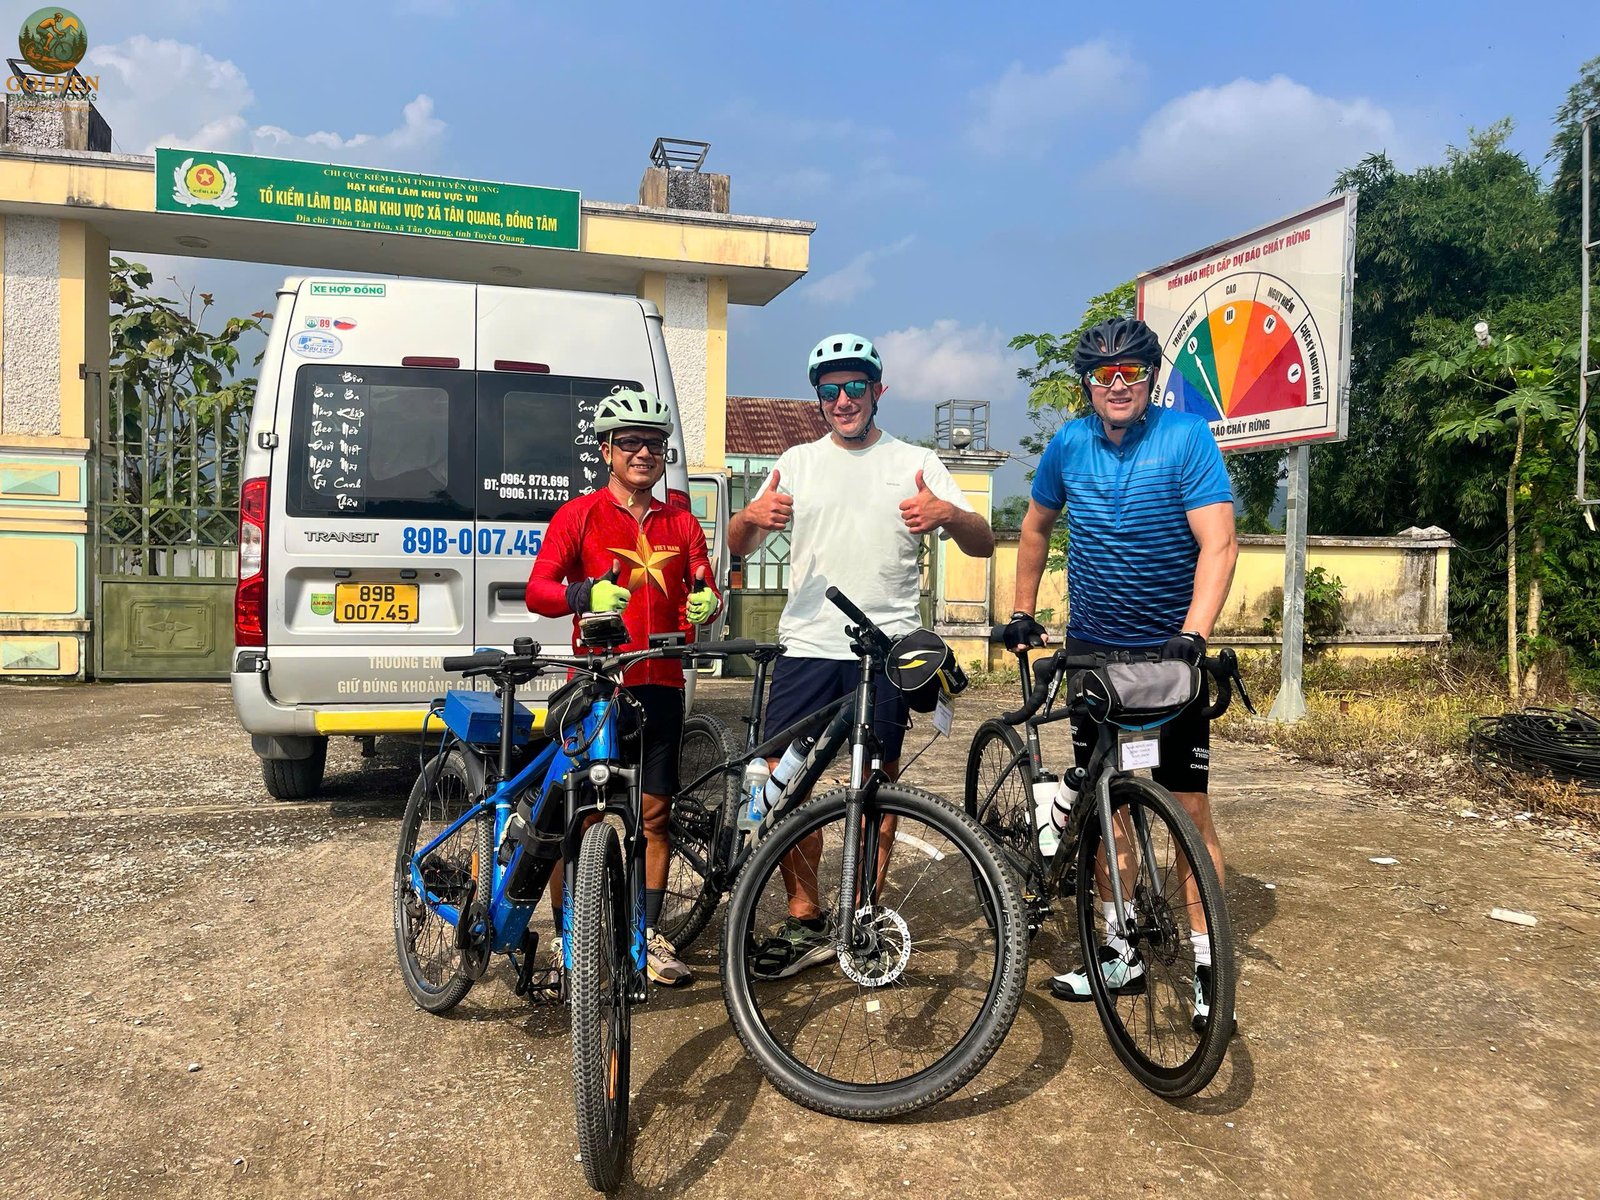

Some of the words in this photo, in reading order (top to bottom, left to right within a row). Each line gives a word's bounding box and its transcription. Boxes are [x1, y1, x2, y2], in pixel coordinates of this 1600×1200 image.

[323, 169, 340, 177] CHI
[342, 172, 361, 180] CỤC
[390, 174, 411, 184] LÂM
[437, 179, 466, 190] TUYÊN
[468, 185, 499, 194] QUANG
[347, 182, 365, 192] HẠT
[397, 186, 418, 197] LÂM
[421, 190, 441, 199] KHU
[443, 191, 463, 202] VỰC
[465, 194, 478, 203] VII
[259, 184, 273, 204] TỔ
[276, 186, 304, 207] KIỂM
[307, 191, 330, 209] LÂM
[333, 196, 352, 214] ĐỊA
[354, 197, 377, 214] BÀN
[380, 201, 401, 216] KHU
[403, 203, 424, 221] VỰC
[427, 204, 441, 220] XÃ
[443, 205, 464, 223] TÂN
[466, 209, 504, 228] QUANG,
[506, 210, 533, 229] ĐỒNG
[536, 214, 557, 232] TÂM
[295, 214, 311, 223] Địa
[331, 217, 352, 227] Thôn
[354, 220, 371, 229] Tân
[407, 224, 423, 233] Tân
[473, 231, 497, 241] Tuyên
[498, 234, 525, 244] Quang
[1184, 270, 1198, 284] BÁO
[1199, 264, 1215, 279] HIỆU
[1216, 255, 1232, 273] CẤP
[1233, 253, 1244, 267] DỰ
[1245, 247, 1261, 263] BÁO
[1262, 238, 1285, 256] CHÁY
[1285, 228, 1311, 248] RỪNG
[329, 285, 351, 295] HỢP
[353, 285, 383, 294] ĐỒNG
[1225, 284, 1237, 295] CAO
[1267, 286, 1283, 303] NGUY
[319, 319, 330, 328] 89
[1265, 317, 1275, 330] IV
[1309, 351, 1320, 375] NGUY
[1291, 368, 1299, 377] V
[1312, 376, 1324, 400] HIỂM
[1211, 424, 1225, 437] BÁO
[1226, 421, 1247, 435] CHÁY
[1248, 418, 1270, 432] RỪNG
[484, 478, 499, 491] ĐT:
[500, 473, 526, 485] 0964
[528, 474, 570, 487] 878.696
[500, 487, 570, 501] 0906.11.73.73
[304, 531, 380, 543] TRANSIT
[402, 527, 542, 556] 89B-007.45
[359, 586, 395, 602] 89B
[344, 604, 409, 621] 007.45
[423, 656, 442, 669] EM
[337, 677, 361, 694] GIỮ
[362, 677, 398, 694] ĐÚNG
[401, 675, 453, 693] KHOẢNG
[456, 677, 491, 692] CÁCH
[991, 951, 1012, 1015] BONTRAGER
